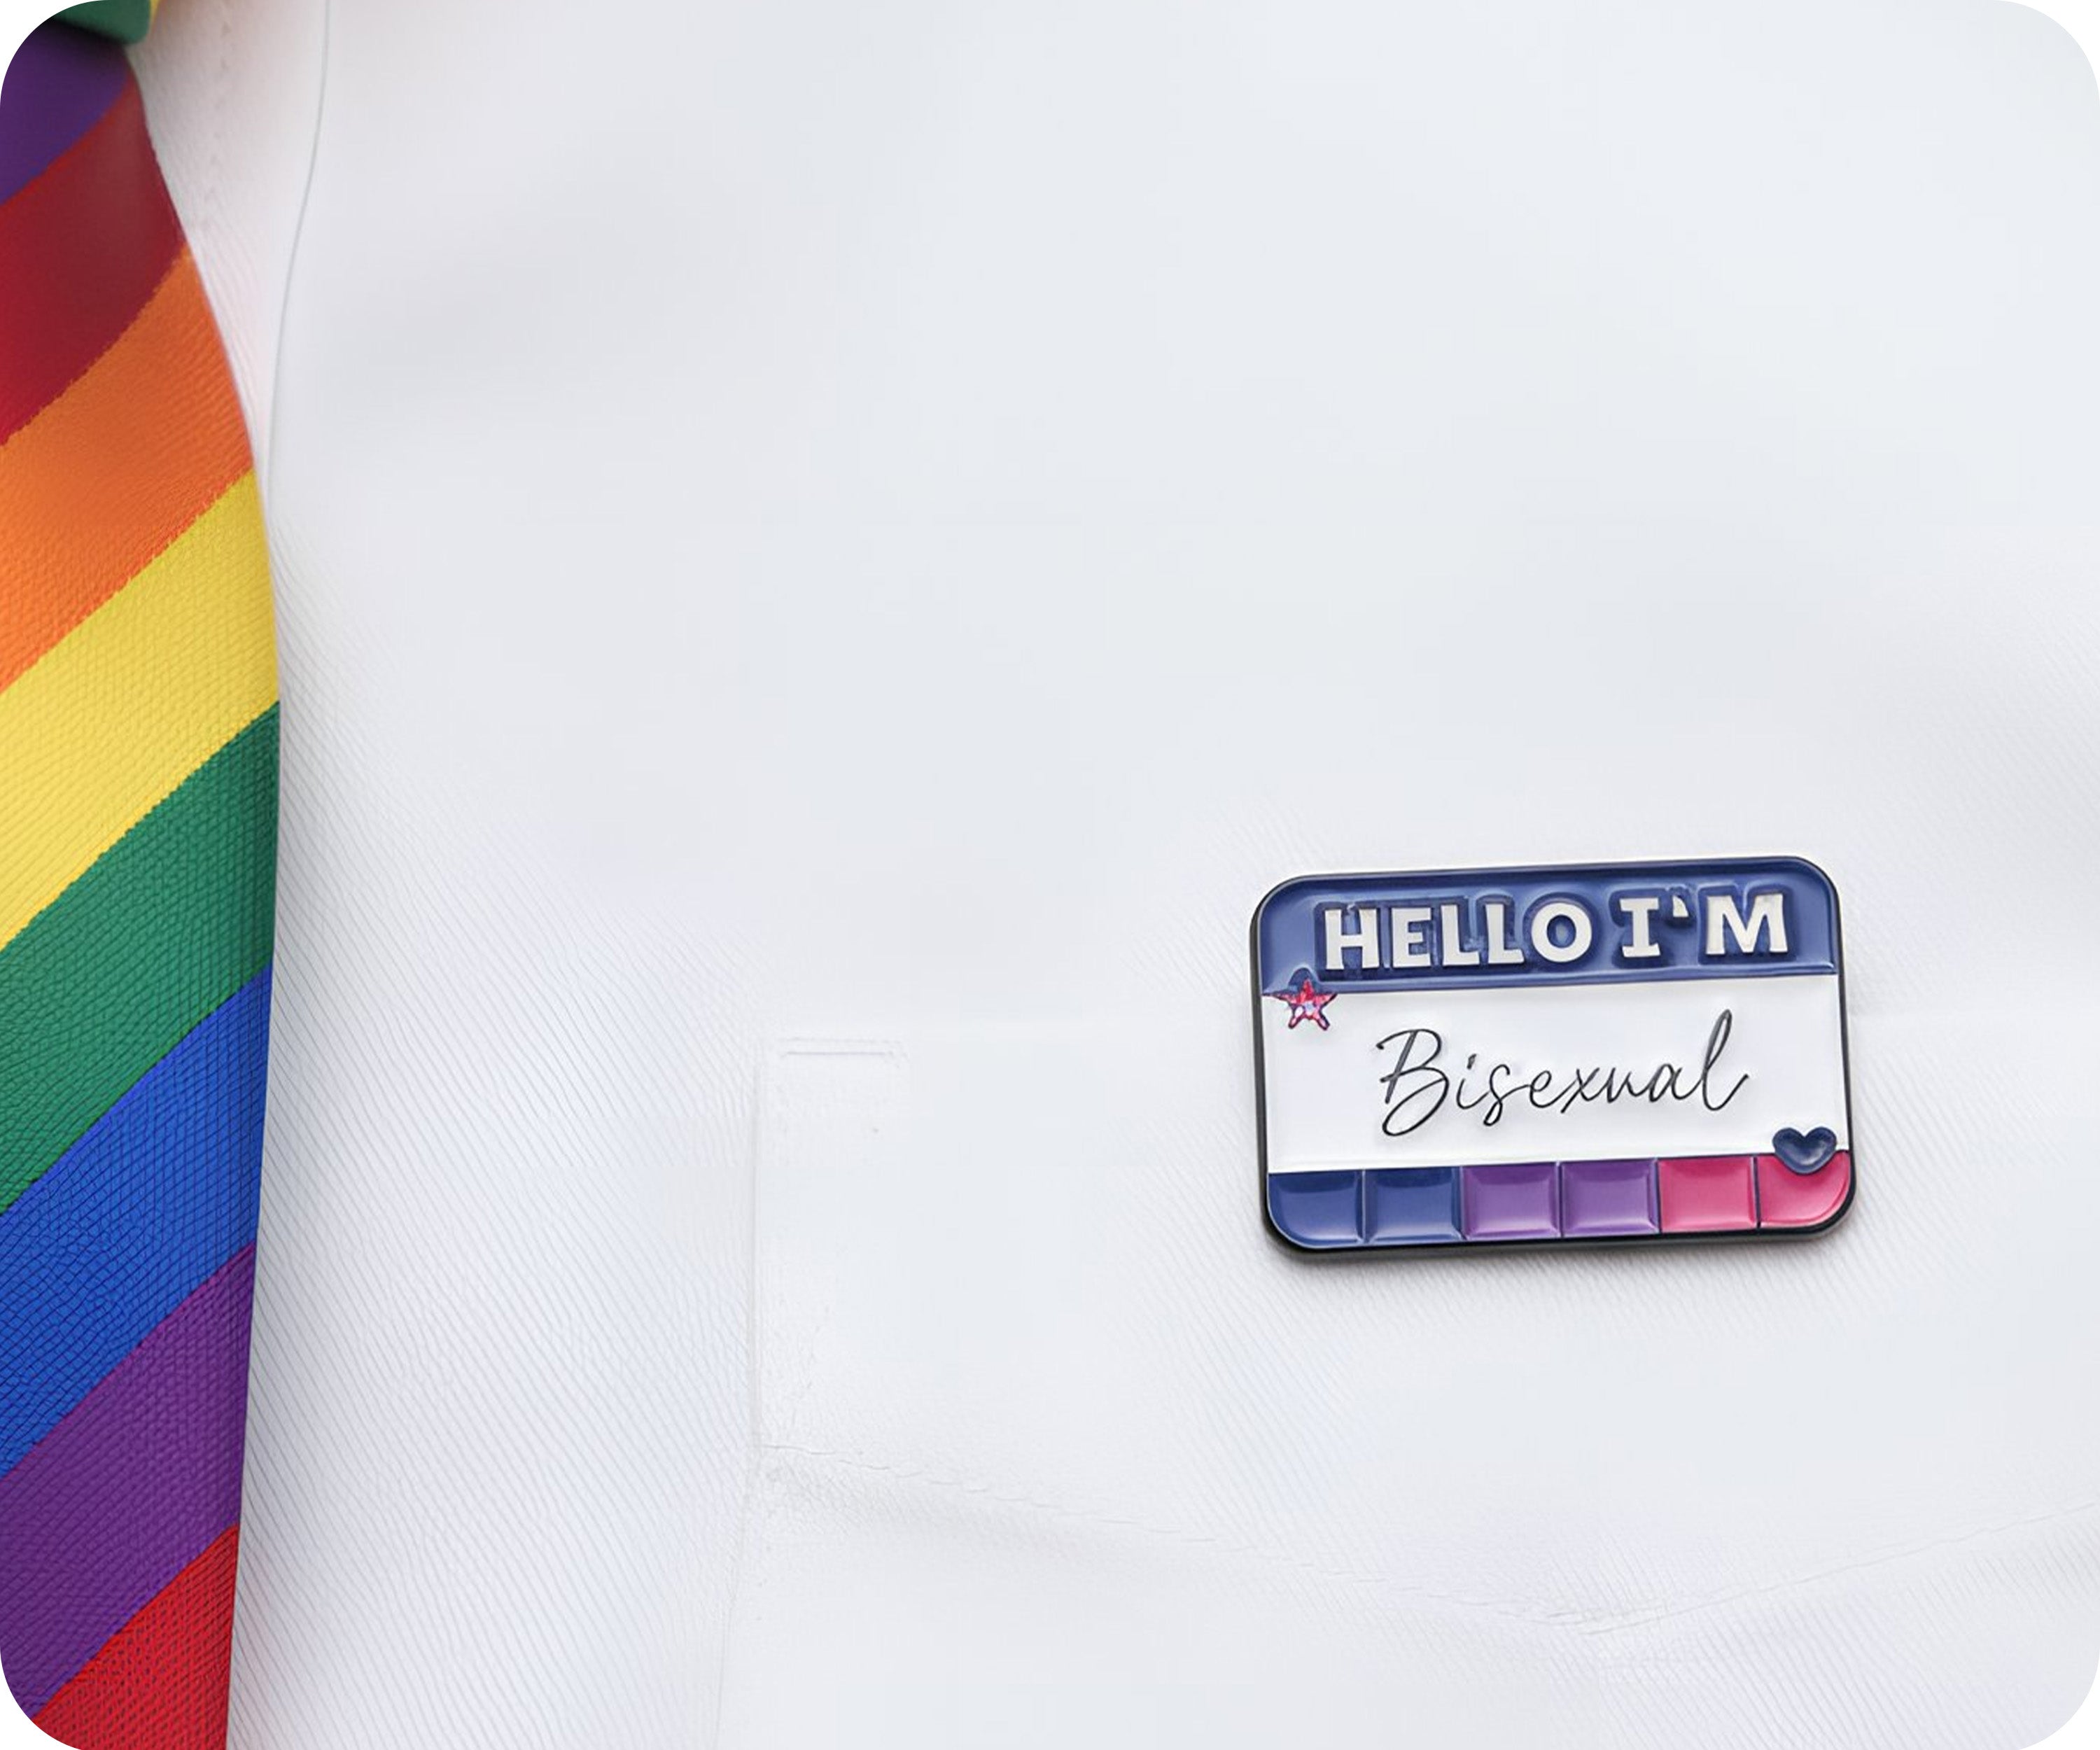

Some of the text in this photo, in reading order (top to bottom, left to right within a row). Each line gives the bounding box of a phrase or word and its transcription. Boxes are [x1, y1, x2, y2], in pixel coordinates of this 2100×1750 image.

[1324, 893, 1788, 970] HELLO I'M
[1376, 1009, 1750, 1137] Bisexual
